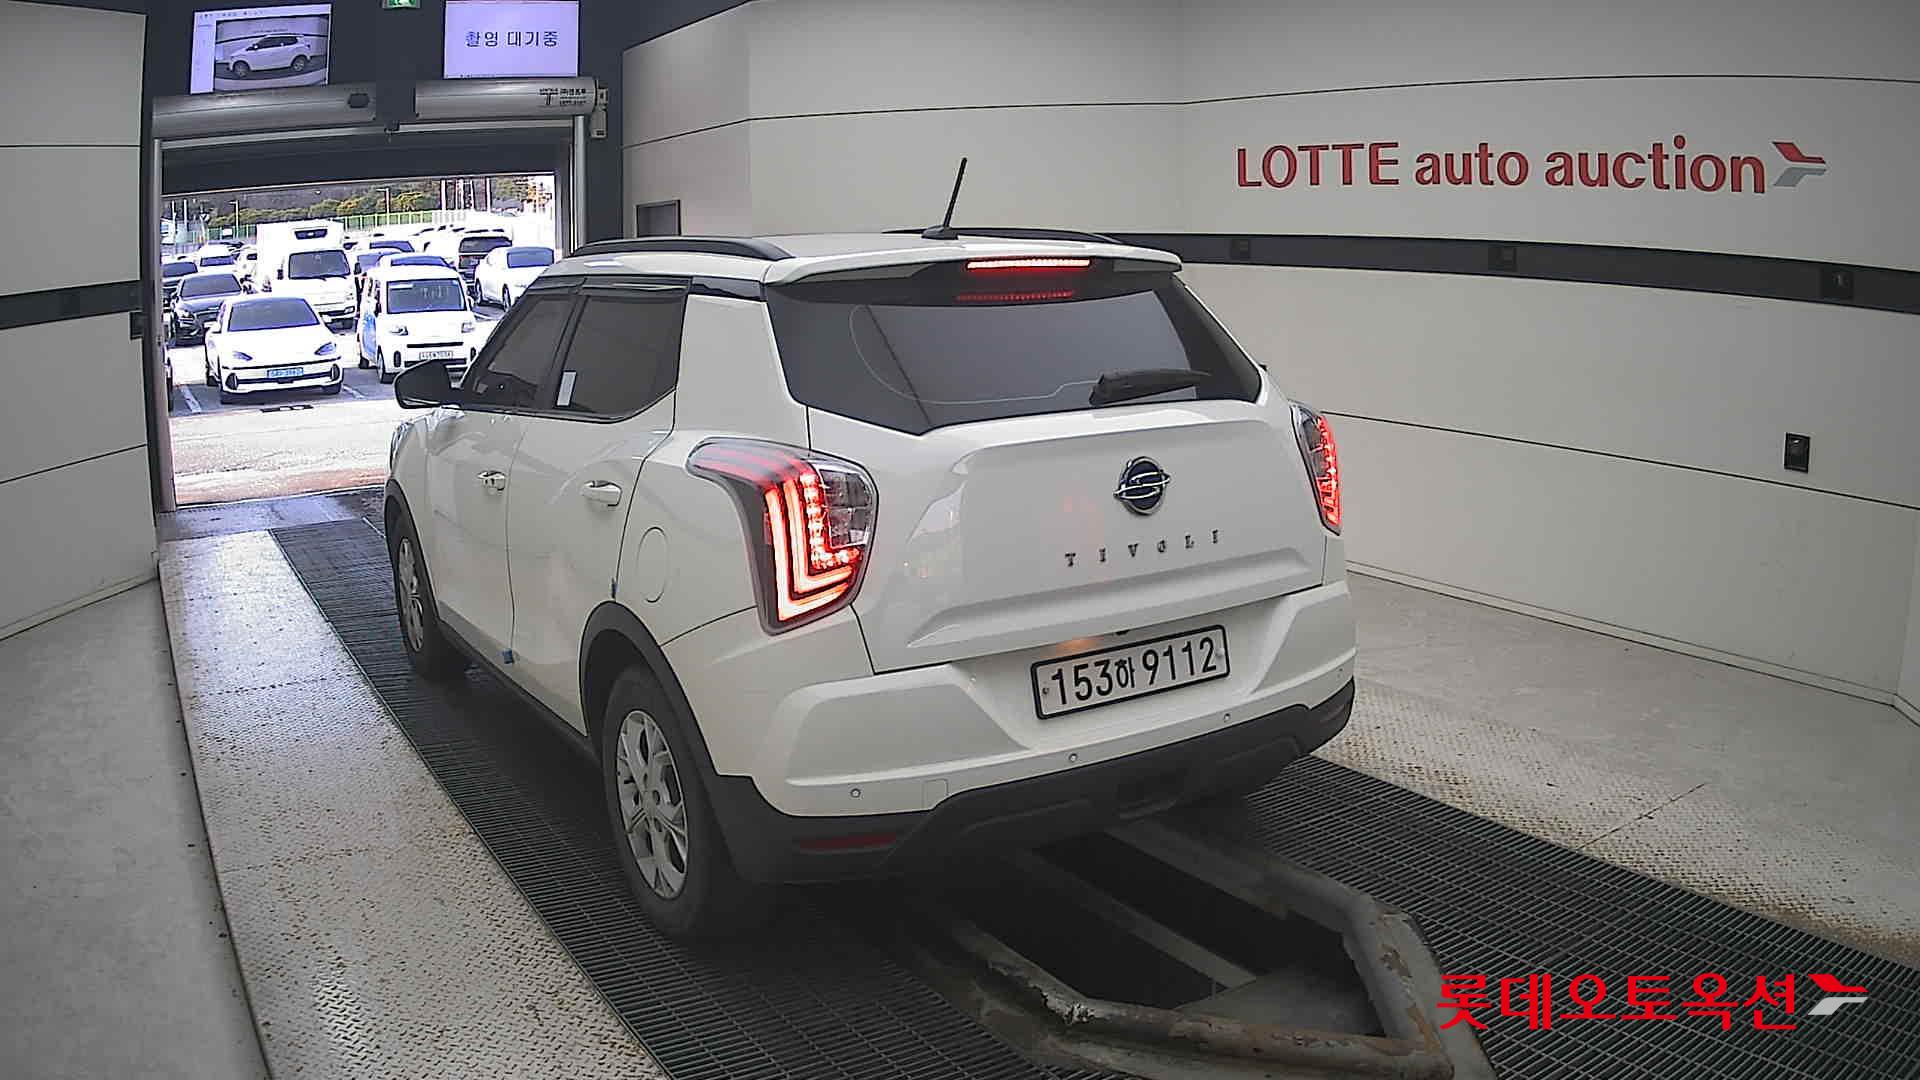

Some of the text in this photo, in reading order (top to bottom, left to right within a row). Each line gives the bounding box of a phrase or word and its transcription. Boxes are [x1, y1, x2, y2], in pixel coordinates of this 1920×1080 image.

[465, 31, 559, 47] 촬영 대기중
[1237, 135, 1766, 193] LOTTE auto auction
[1064, 529, 1219, 567] TIVOLI
[1052, 636, 1217, 705] 153하 9112
